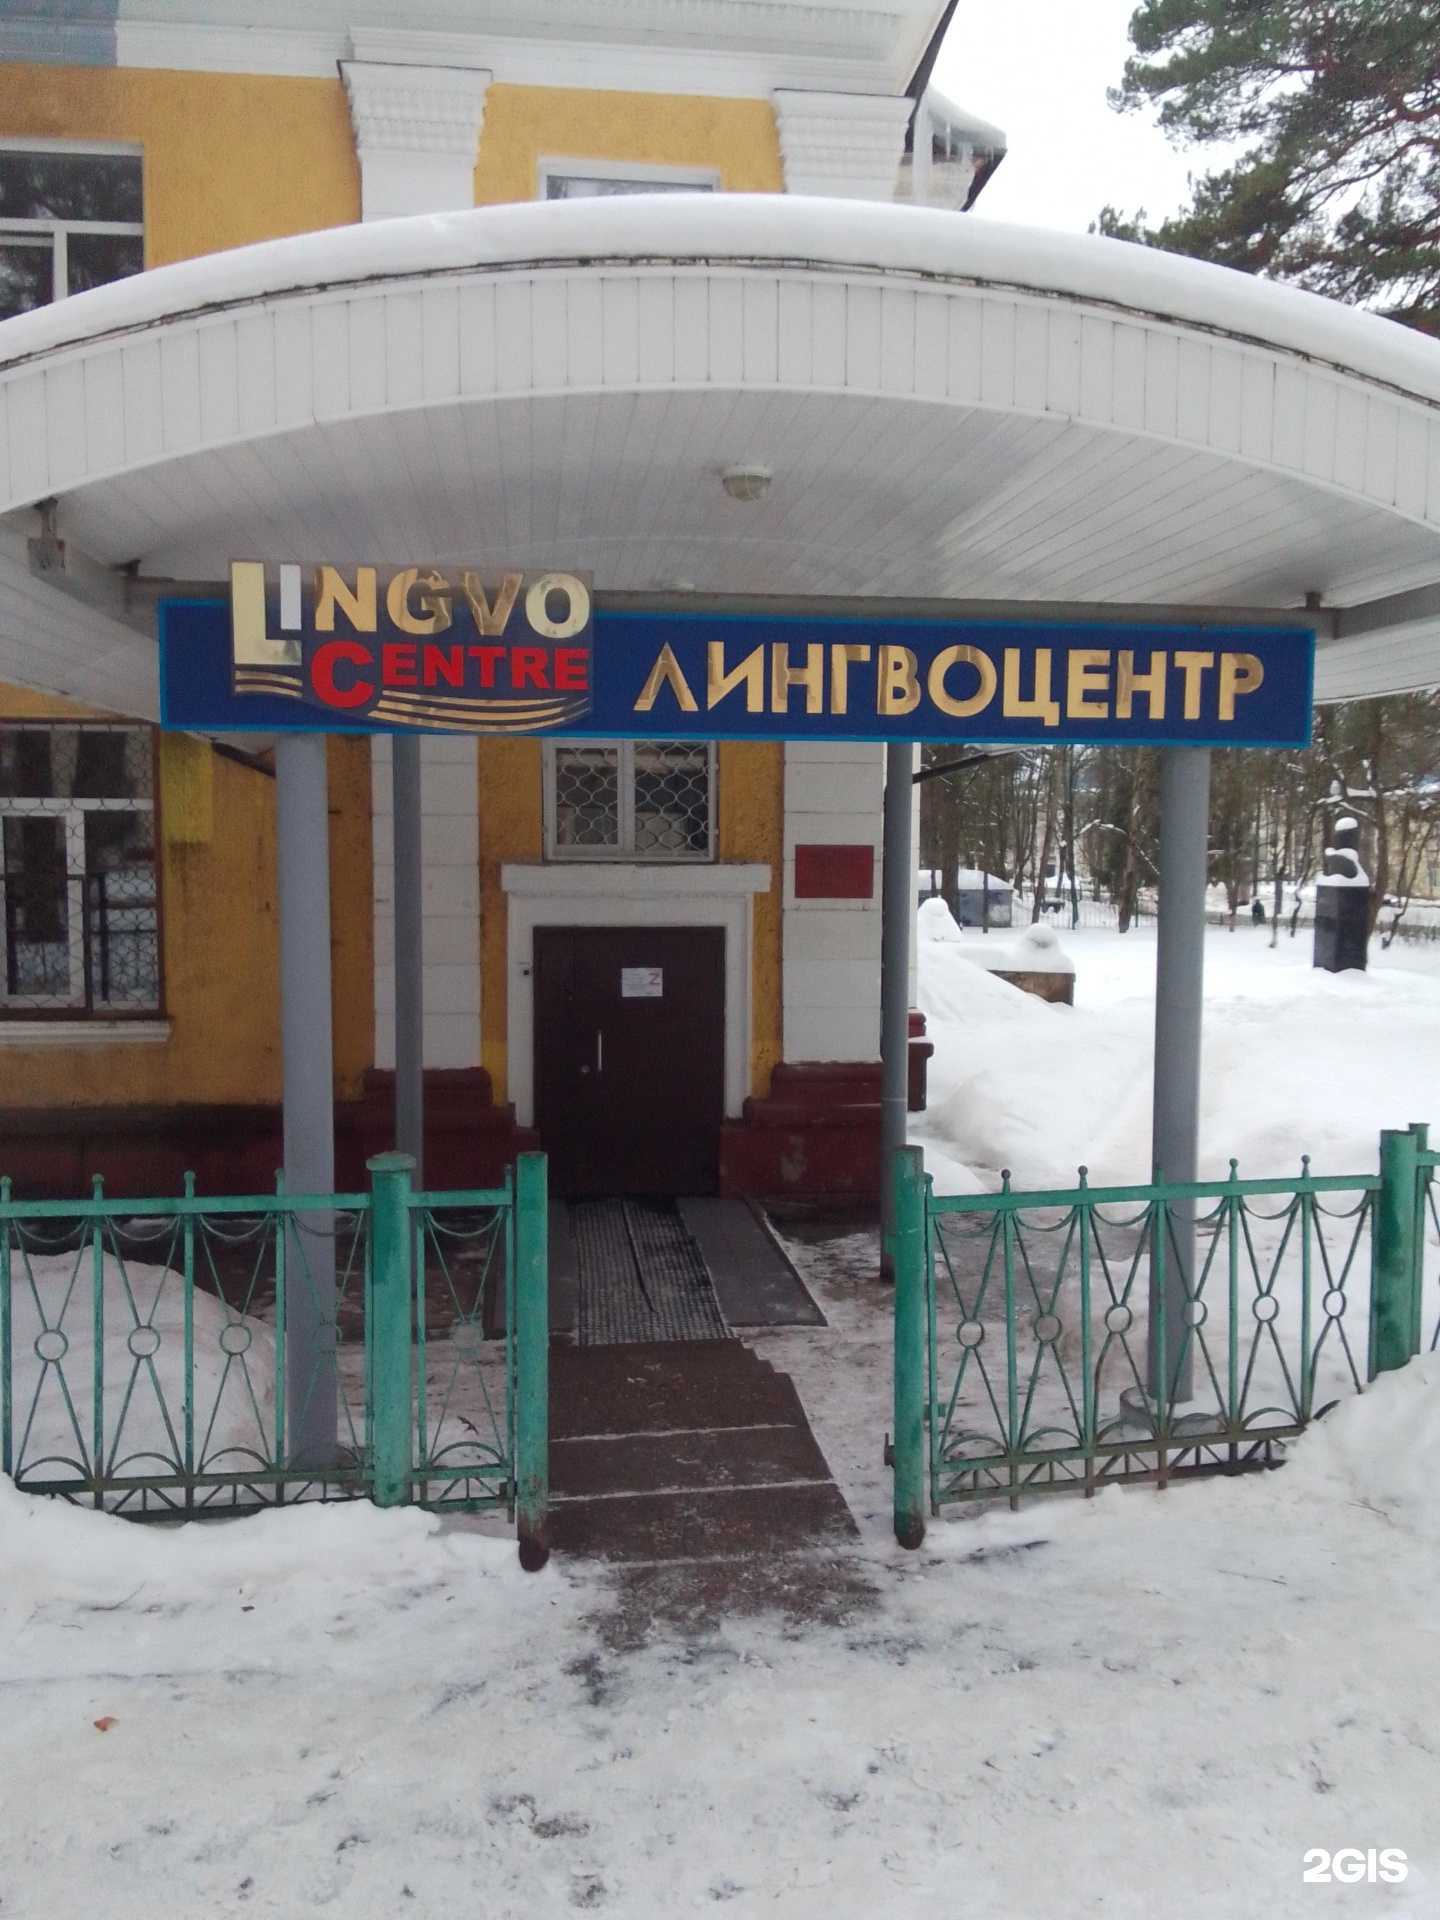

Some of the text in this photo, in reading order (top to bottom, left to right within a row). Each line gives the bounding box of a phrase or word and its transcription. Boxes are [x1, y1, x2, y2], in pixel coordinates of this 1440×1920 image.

[231, 561, 590, 665] LINGVO
[311, 641, 589, 707] CENTRE
[633, 641, 1264, 726] ЛИНГВОЦЕНТР
